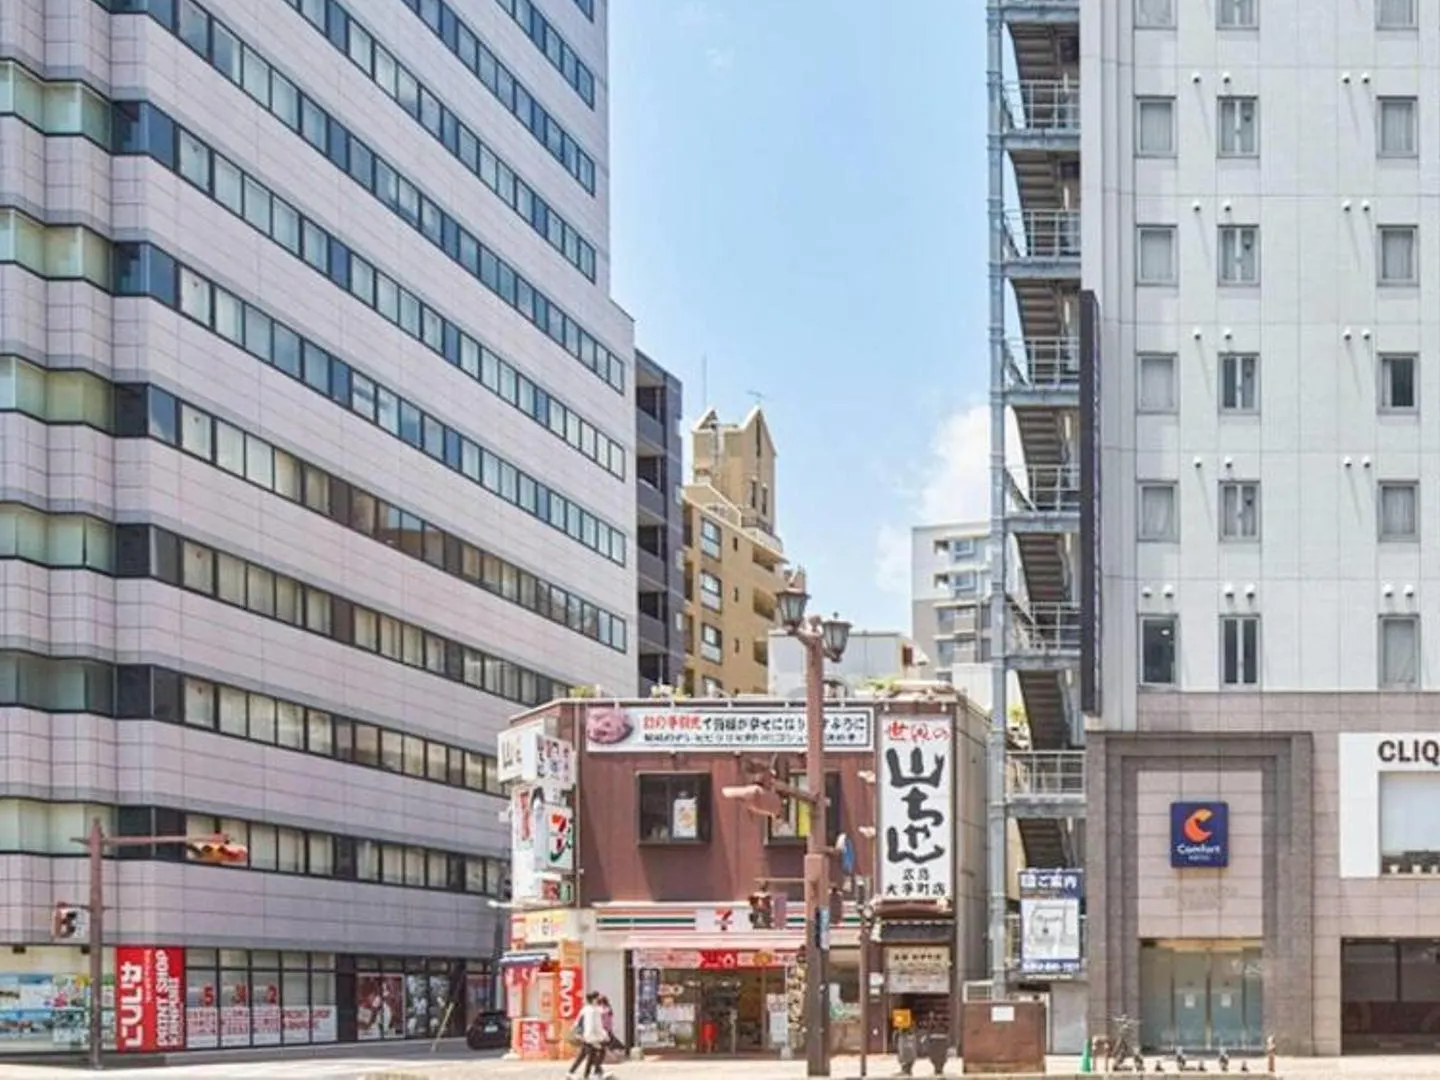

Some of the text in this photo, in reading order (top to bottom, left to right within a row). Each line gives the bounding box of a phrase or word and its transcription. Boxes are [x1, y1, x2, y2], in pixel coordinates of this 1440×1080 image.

[888, 721, 951, 742] 世界の
[886, 747, 945, 864] 山ちゃん
